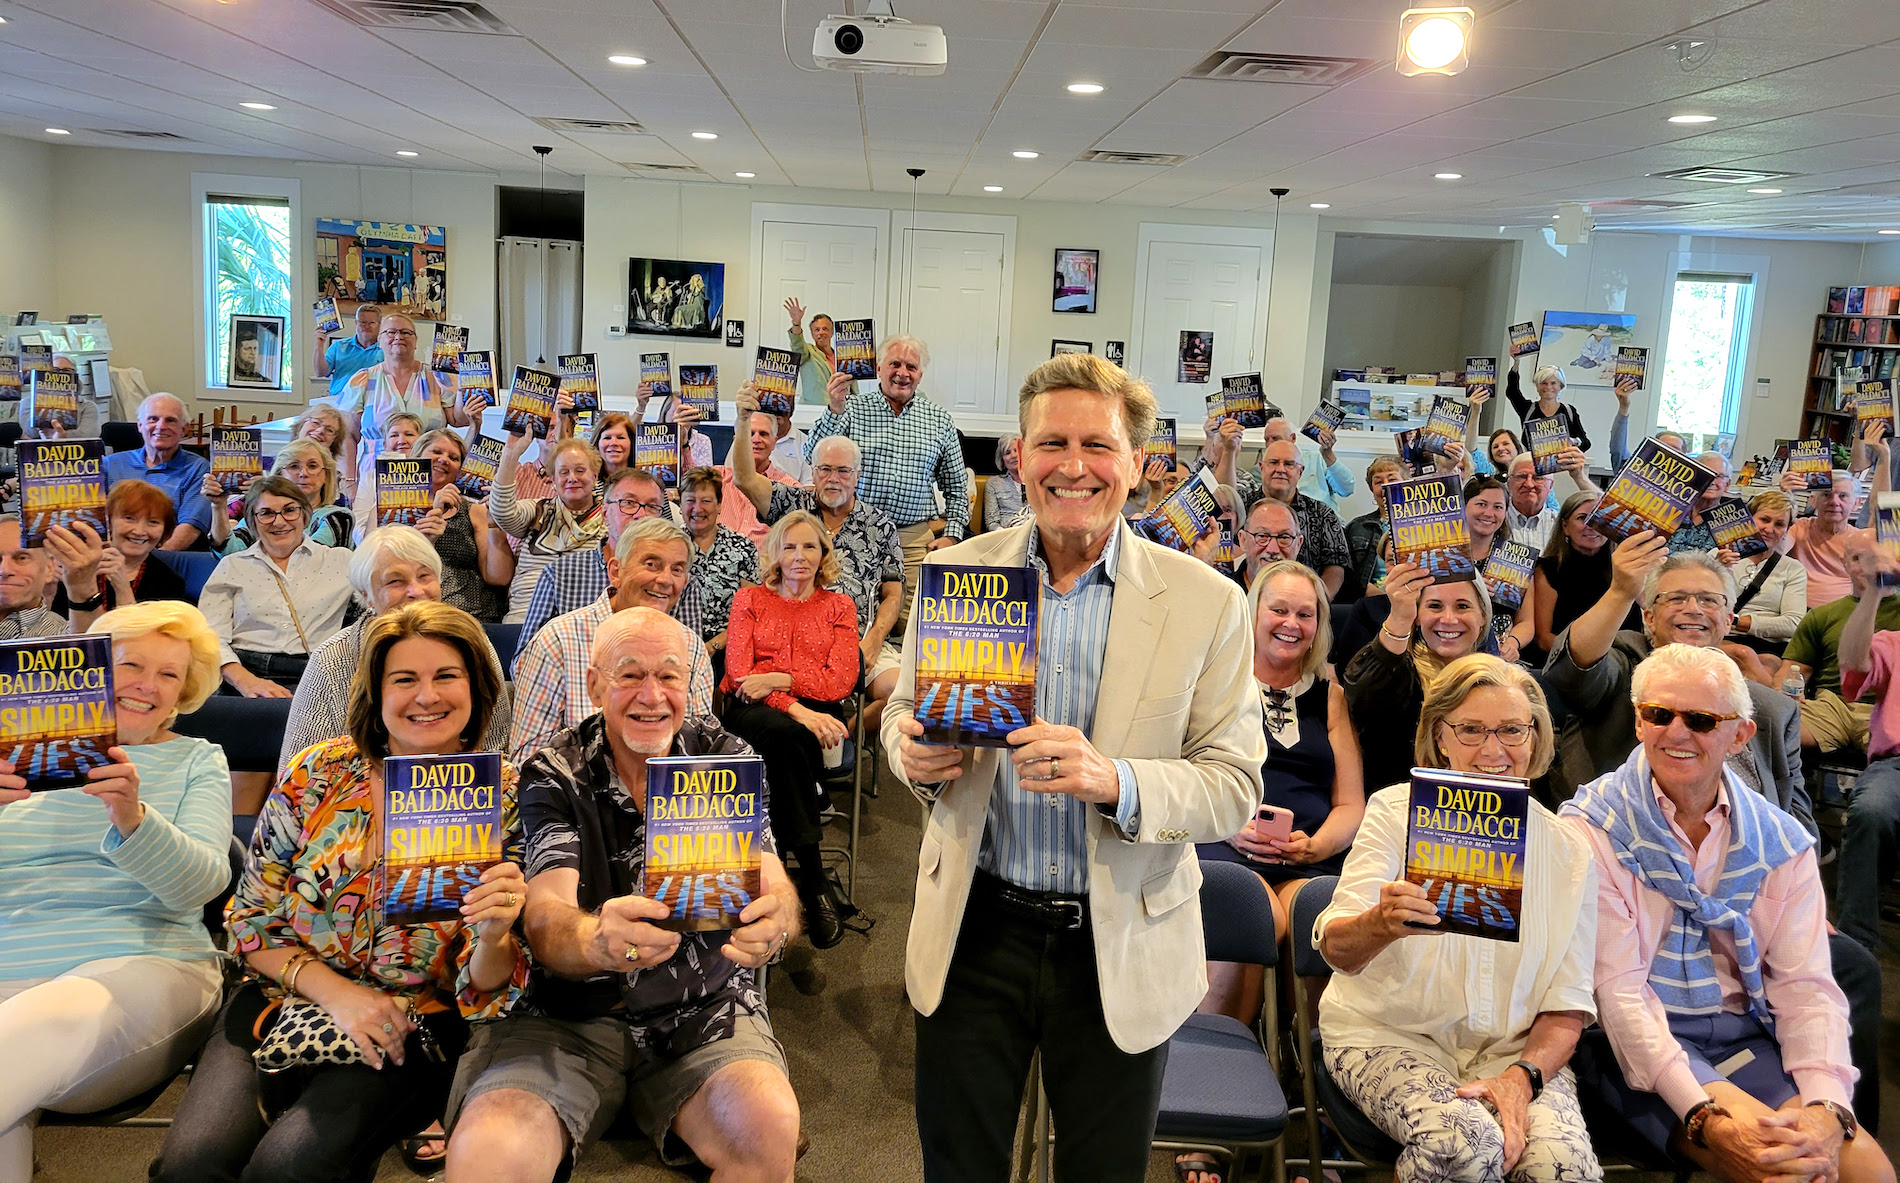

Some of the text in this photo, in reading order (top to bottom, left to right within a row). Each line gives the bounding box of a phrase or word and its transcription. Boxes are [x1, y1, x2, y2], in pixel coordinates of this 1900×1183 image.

[443, 327, 462, 337] DAVID
[842, 322, 864, 332] DAVID
[836, 330, 871, 341] BALDACCI
[463, 354, 482, 363] DAVID
[766, 350, 791, 363] DAVID
[838, 344, 872, 359] SIMPLY
[459, 362, 489, 371] BALDACCI
[565, 356, 587, 366] DAVID
[757, 359, 797, 375] BALDACCI
[44, 371, 70, 383] DAVID
[559, 364, 594, 375] BALDACCI
[37, 381, 77, 392] BALDACCI
[461, 375, 490, 388] SIMPLY
[525, 372, 551, 386] DAVID
[562, 378, 594, 391] SIMPLY
[755, 374, 794, 394] SIMPLY
[1229, 378, 1251, 388] DAVID
[1861, 382, 1882, 391] DAVID
[515, 379, 557, 397] BALDACCI
[682, 386, 713, 399] SIMPLY
[1224, 384, 1258, 396] BALDACCI
[36, 393, 77, 409] SIMPLY
[511, 394, 553, 416] SIMPLY
[1227, 397, 1260, 412] SIMPLY
[1442, 400, 1462, 413] DAVID
[1434, 406, 1466, 424] BALDACCI
[1858, 403, 1890, 418] SIMPLY
[644, 425, 669, 436] DAVID
[1428, 419, 1462, 440] SIMPLY
[1530, 425, 1567, 440] BALDACCI
[1535, 419, 1558, 431] DAVID
[222, 431, 250, 441] DAVID
[637, 434, 675, 446] BALDACCI
[214, 440, 259, 451] BALDACCI
[481, 438, 503, 452] DAVID
[1533, 438, 1568, 457] SIMPLY
[1791, 447, 1828, 457] BALDACCI
[1797, 440, 1822, 449] DAVID
[37, 445, 84, 461] DAVID
[471, 444, 500, 462] BALDAC
[637, 449, 675, 464] SIMPLY
[24, 460, 99, 478] BALDACCI
[213, 457, 258, 470] SIMPLY
[388, 462, 420, 473] DAVID
[1650, 450, 1695, 483] DAVID
[1792, 459, 1828, 471] SIMPLY
[379, 471, 430, 485] BALDACCI
[1629, 457, 1699, 503] BALDACCI
[27, 483, 100, 507] SIMPLY
[381, 490, 430, 506] SIMPLY
[1193, 485, 1216, 512] DAVID
[1403, 482, 1446, 501] DAVID
[1179, 486, 1210, 529] BALDACCI
[1392, 495, 1462, 520] BALDACCI
[1612, 478, 1683, 528] SIMPLY
[1707, 508, 1748, 529] BALDACCI
[1710, 504, 1736, 519] DAVID
[1168, 498, 1200, 542] SIMPLY
[1397, 519, 1464, 548] SIMPLY
[1715, 521, 1754, 546] SIMPLY
[1504, 541, 1530, 557] DAVID
[1493, 548, 1535, 569] BALDACCI
[1487, 562, 1529, 587] SIMPLY
[943, 572, 1008, 599] DAVID
[921, 597, 1028, 627] BALDACCI
[17, 647, 85, 672] DAVID
[921, 637, 1025, 677] SIMPLY
[0, 667, 106, 696] BALDACCI
[916, 682, 1027, 733] LIES
[1, 701, 105, 738] SIMPLY
[410, 763, 475, 789] DAVID
[672, 769, 737, 795] DAVID
[390, 786, 494, 814] BALDACCI
[651, 793, 755, 820] BALDACCI
[1437, 785, 1502, 814] DAVID
[1415, 806, 1520, 840] BALDACCI
[390, 823, 493, 862] SIMPLY
[652, 831, 754, 866] SIMPLY
[1413, 841, 1517, 884] SIMPLY
